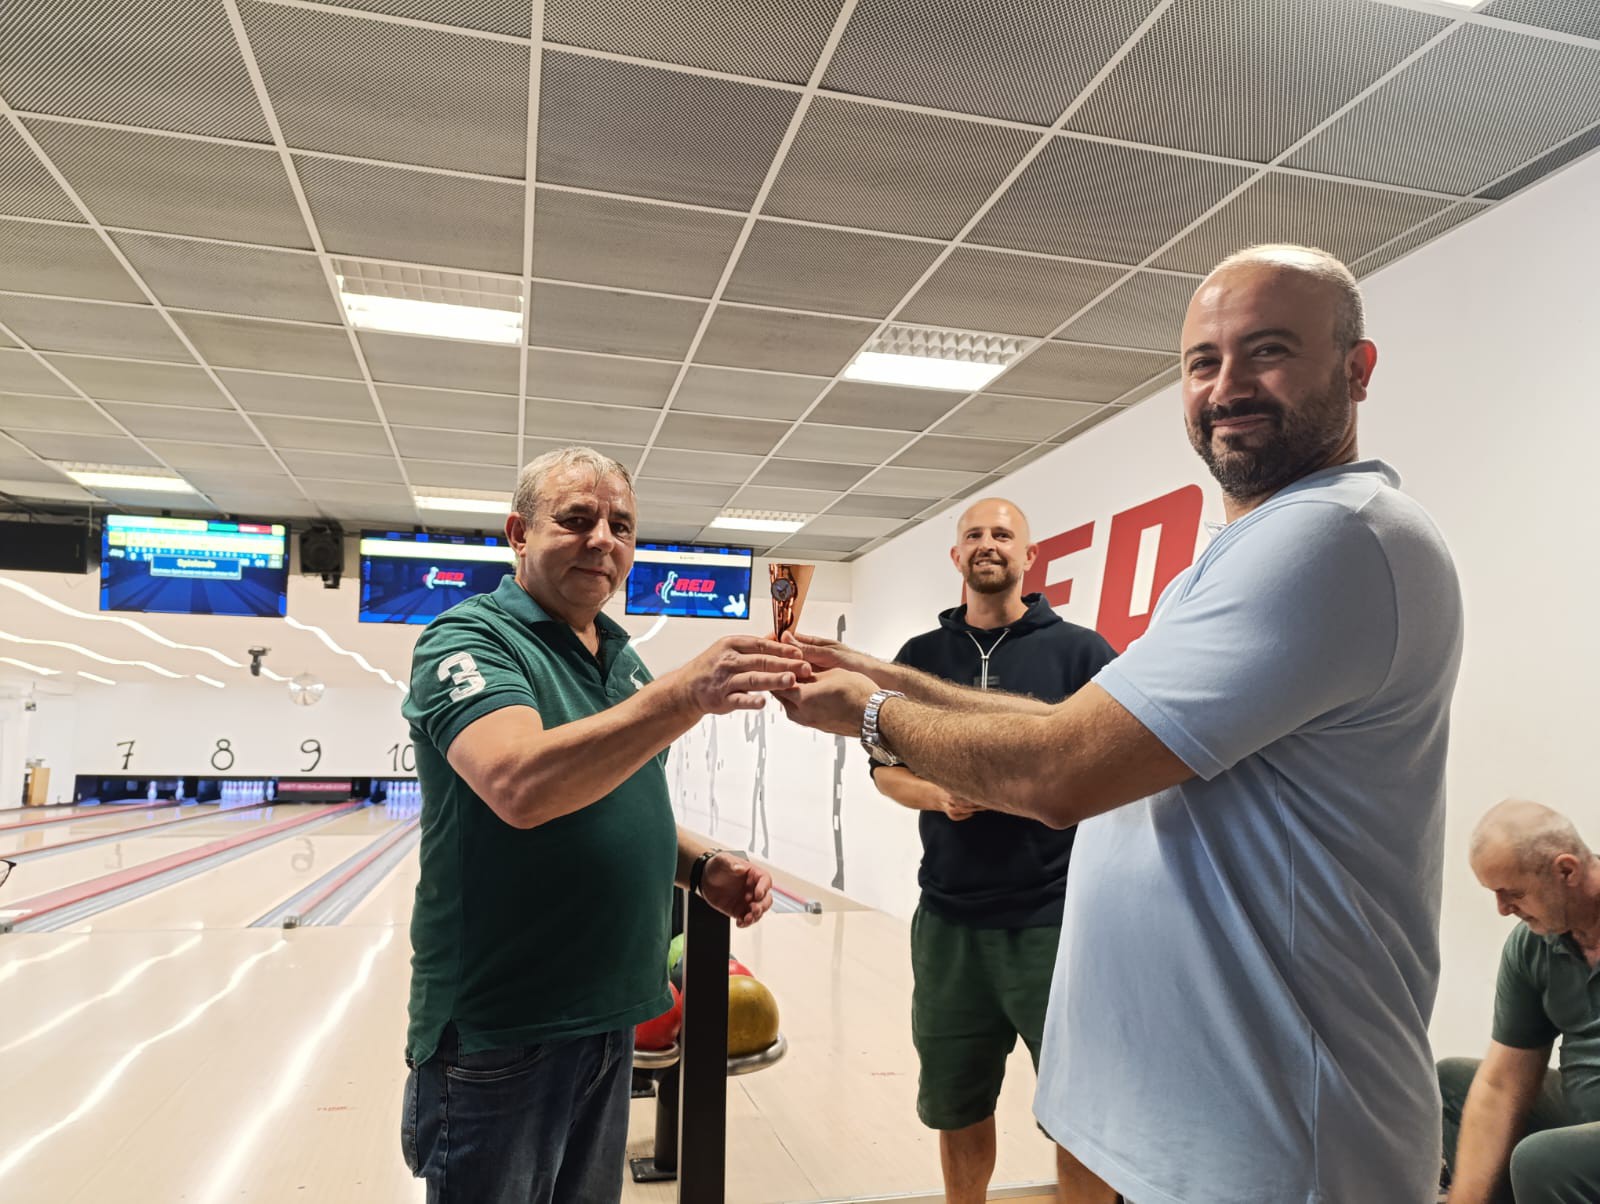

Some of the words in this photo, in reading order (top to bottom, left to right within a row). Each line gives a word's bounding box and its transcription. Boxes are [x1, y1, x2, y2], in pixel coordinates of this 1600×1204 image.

[675, 578, 716, 592] RED
[961, 484, 1203, 656] ED
[437, 651, 486, 703] 3
[116, 740, 136, 770] 7
[211, 738, 235, 771] 8
[300, 739, 322, 772] 9
[387, 742, 416, 772] 10
